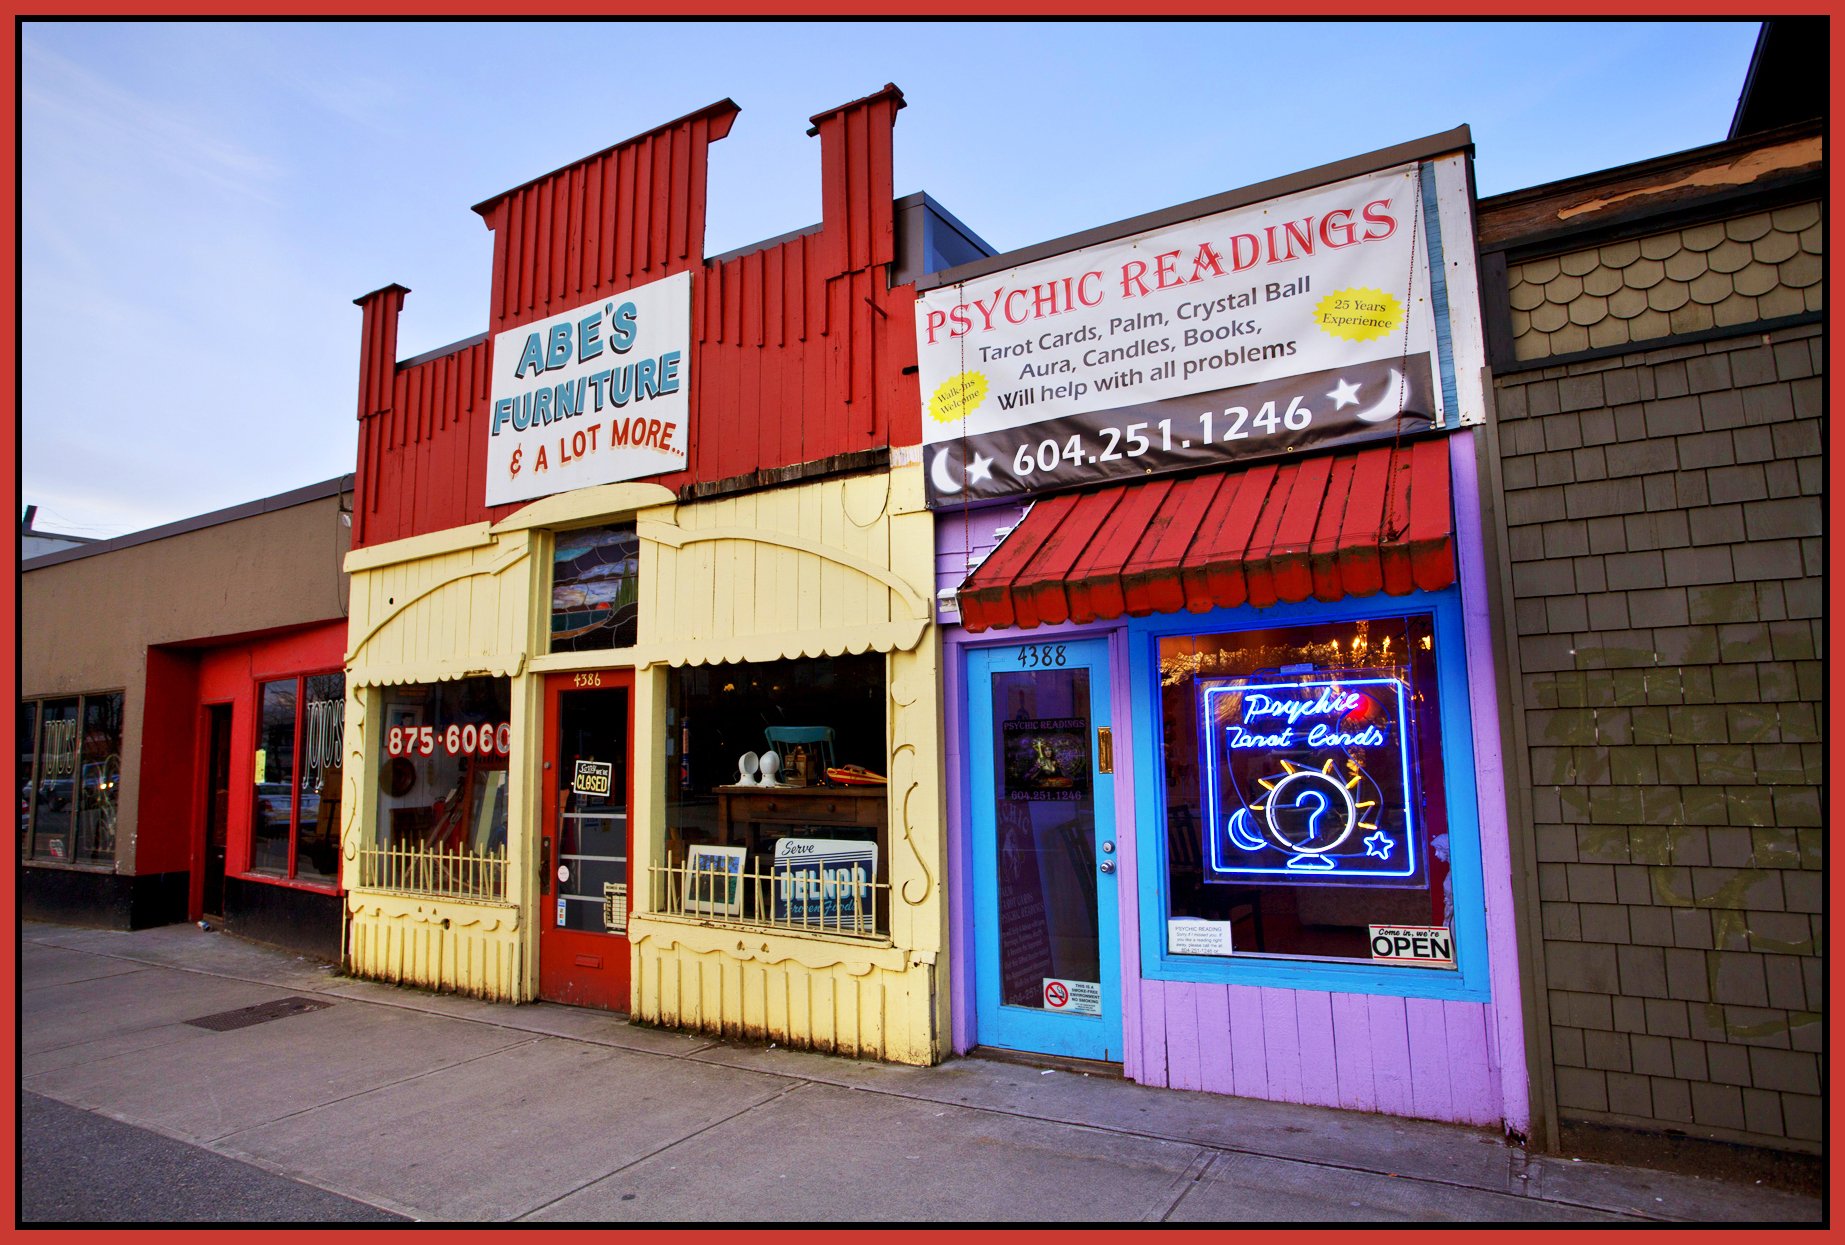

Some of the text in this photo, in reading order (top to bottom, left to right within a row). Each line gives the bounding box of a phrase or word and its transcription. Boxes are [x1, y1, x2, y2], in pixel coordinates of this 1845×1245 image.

[926, 198, 1398, 345] PSYCHIC READINGS
[1334, 299, 1386, 313] 25 Years
[979, 275, 1310, 363] Tarot Cards, Palm, Crystal Ball
[1322, 313, 1393, 329] Experience
[514, 301, 638, 379] ABE'S
[1019, 319, 1262, 380] Aura, Candles, Books,
[997, 340, 1297, 411] Will help with all problems
[491, 350, 681, 436] FURNITURE
[936, 378, 976, 404] Walk-Ins
[940, 389, 980, 416] Welcome
[534, 444, 548, 472] A
[560, 424, 601, 464] LOT
[611, 417, 685, 456] MORE...
[1012, 395, 1312, 476] 604.251.1246
[1017, 645, 1066, 667] 4388
[573, 672, 601, 687] 4386
[1244, 687, 1360, 724] Psychic
[1004, 719, 1086, 730] PSYCHIC READINGS
[1226, 723, 1384, 748] Tarot Cards
[576, 773, 608, 792] CLOSED
[1011, 791, 1082, 800] 604.251.1246
[781, 840, 815, 856] Serve
[1378, 928, 1440, 937] Come in, we're
[1371, 936, 1451, 959] OPEN
